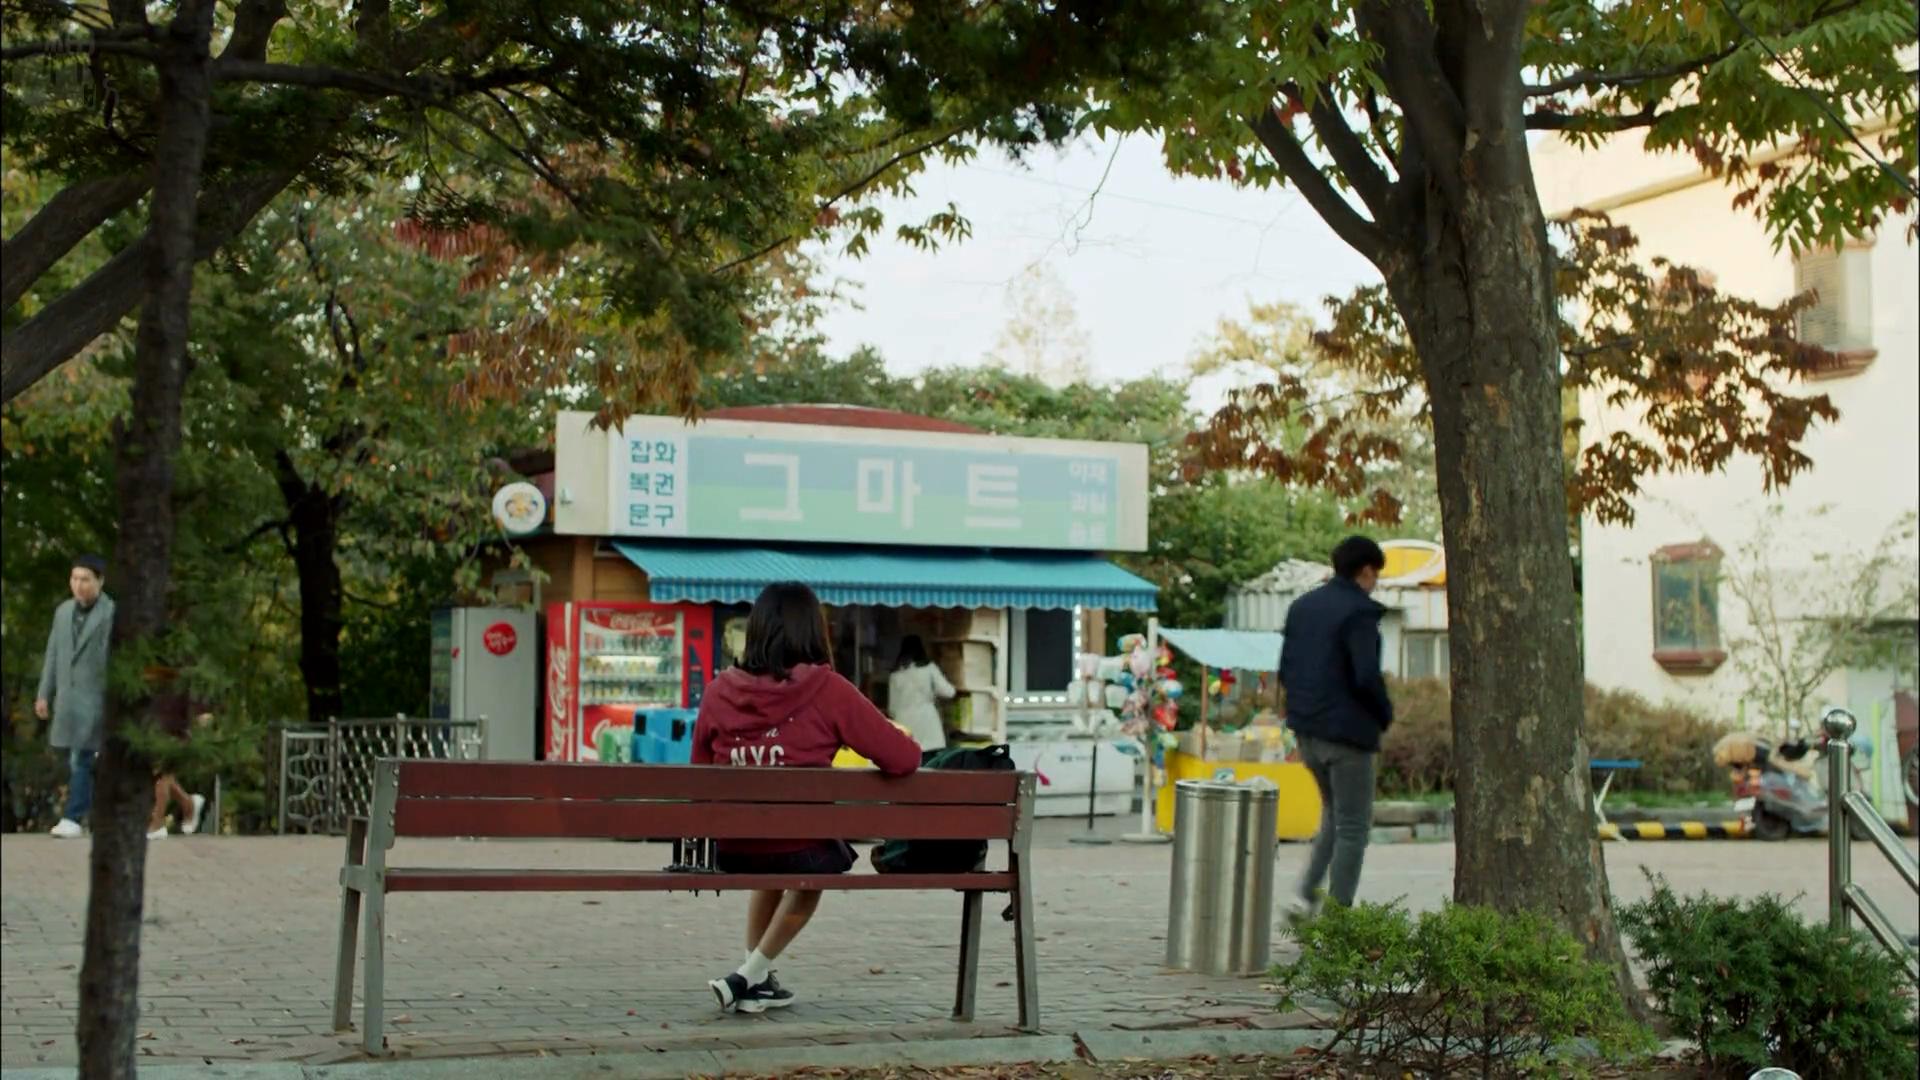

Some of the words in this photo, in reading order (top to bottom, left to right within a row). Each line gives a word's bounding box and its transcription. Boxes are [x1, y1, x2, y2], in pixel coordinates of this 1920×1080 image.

[630, 440, 677, 464] 잡화
[630, 471, 675, 496] 복권
[742, 452, 1022, 530] 그마트
[629, 503, 674, 528] 문구
[730, 744, 785, 767] NYC
